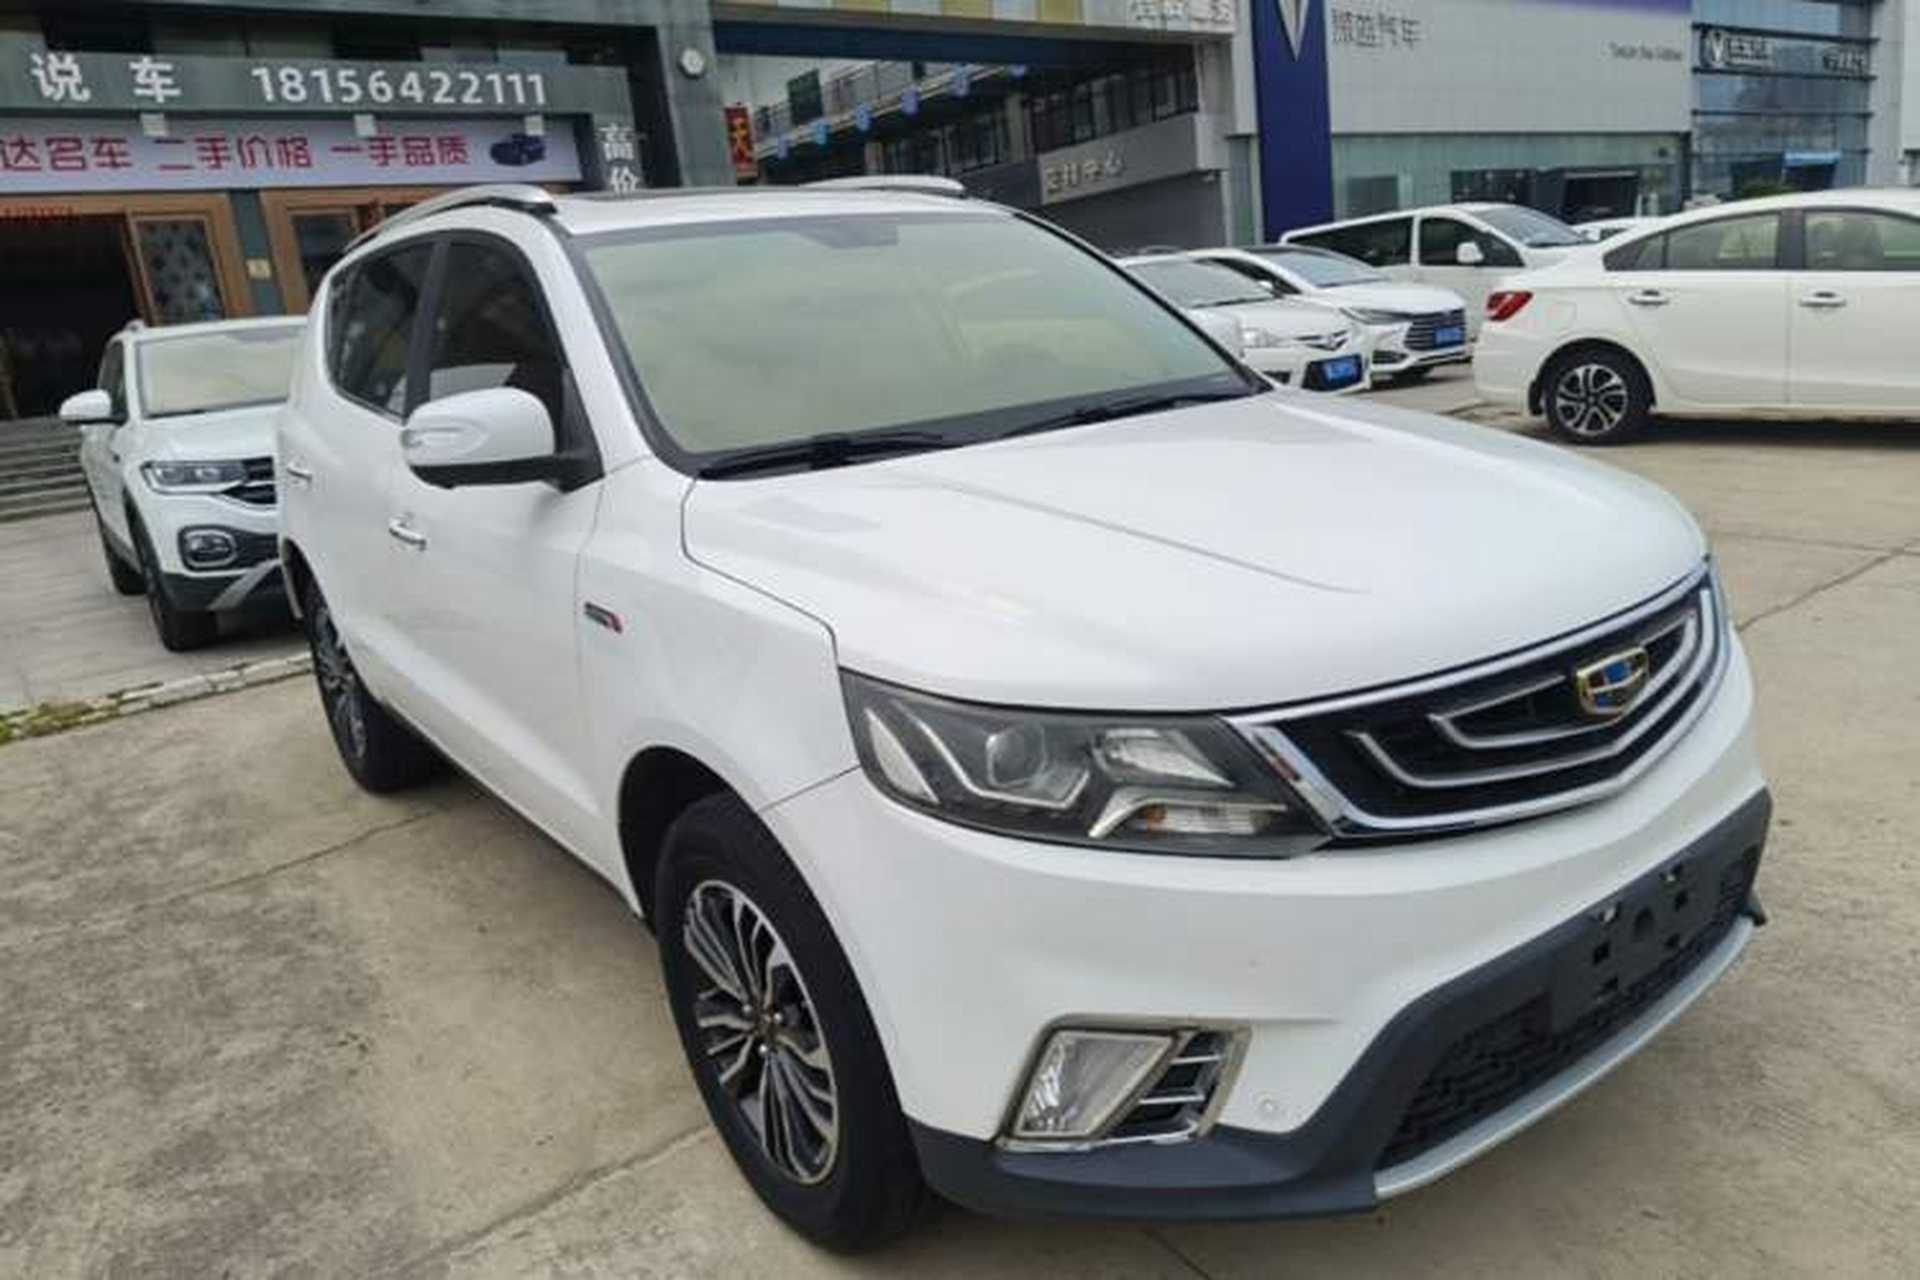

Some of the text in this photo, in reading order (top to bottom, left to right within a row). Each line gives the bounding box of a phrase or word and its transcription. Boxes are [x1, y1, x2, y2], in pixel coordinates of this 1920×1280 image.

[251, 66, 547, 105] 18156422111
[152, 134, 312, 171] 二手价格
[329, 131, 471, 167] 一手品质
